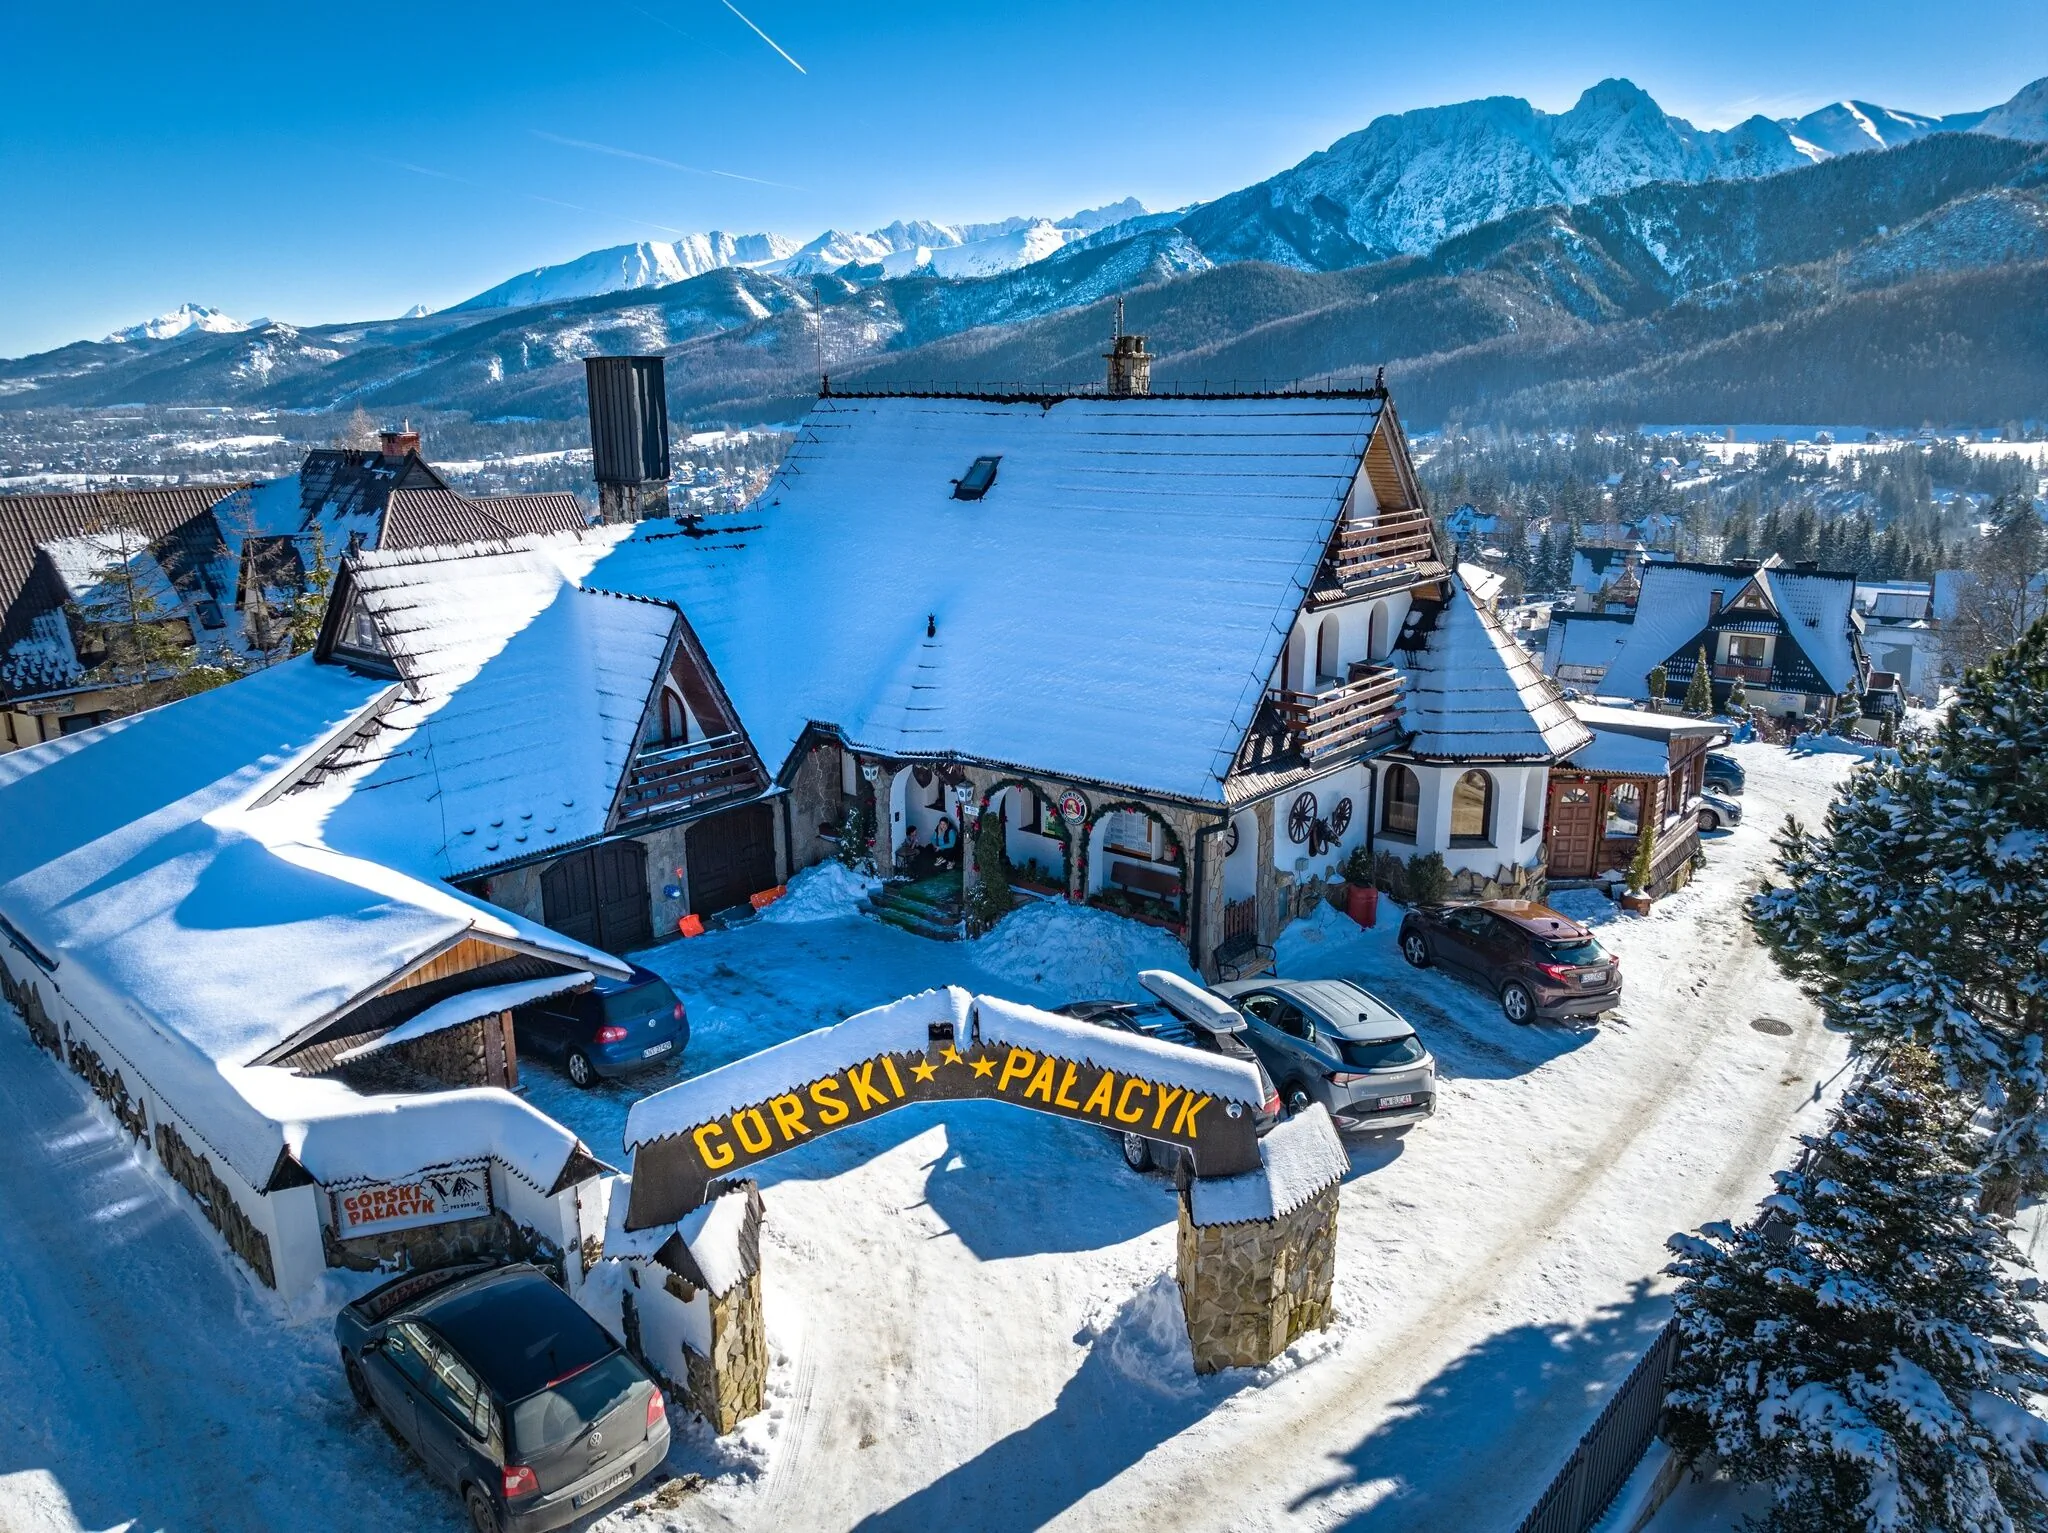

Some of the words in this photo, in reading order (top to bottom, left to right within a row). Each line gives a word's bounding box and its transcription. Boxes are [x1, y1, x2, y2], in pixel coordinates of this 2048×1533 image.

[998, 1048, 1211, 1138] PAŁACYK
[344, 1186, 421, 1211] GÓRSKI
[348, 1199, 435, 1226] PAŁACYK
